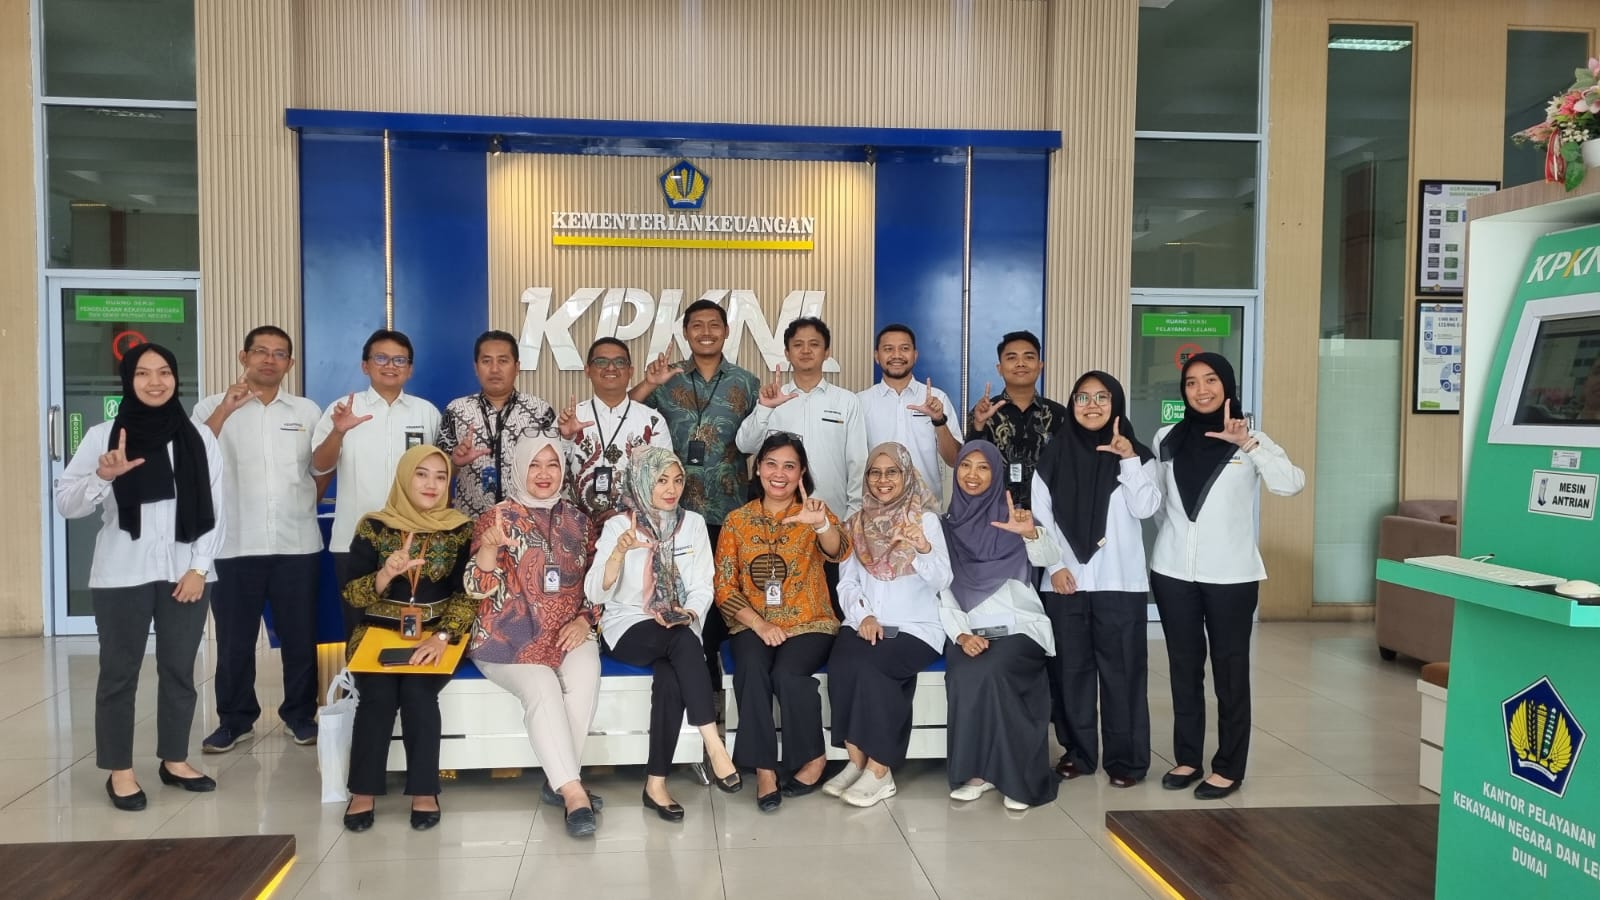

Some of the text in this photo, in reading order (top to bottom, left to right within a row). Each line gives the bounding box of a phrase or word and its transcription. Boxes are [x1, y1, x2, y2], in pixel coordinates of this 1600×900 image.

[1552, 495, 1590, 509] ANTRIAN
[1559, 482, 1586, 495] MESIN
[1483, 781, 1596, 849] KANTOR PELAYANAN
[1453, 791, 1600, 881] KEKAYAAN NEGARA DAN LE
[1512, 846, 1548, 879] DUMAI
